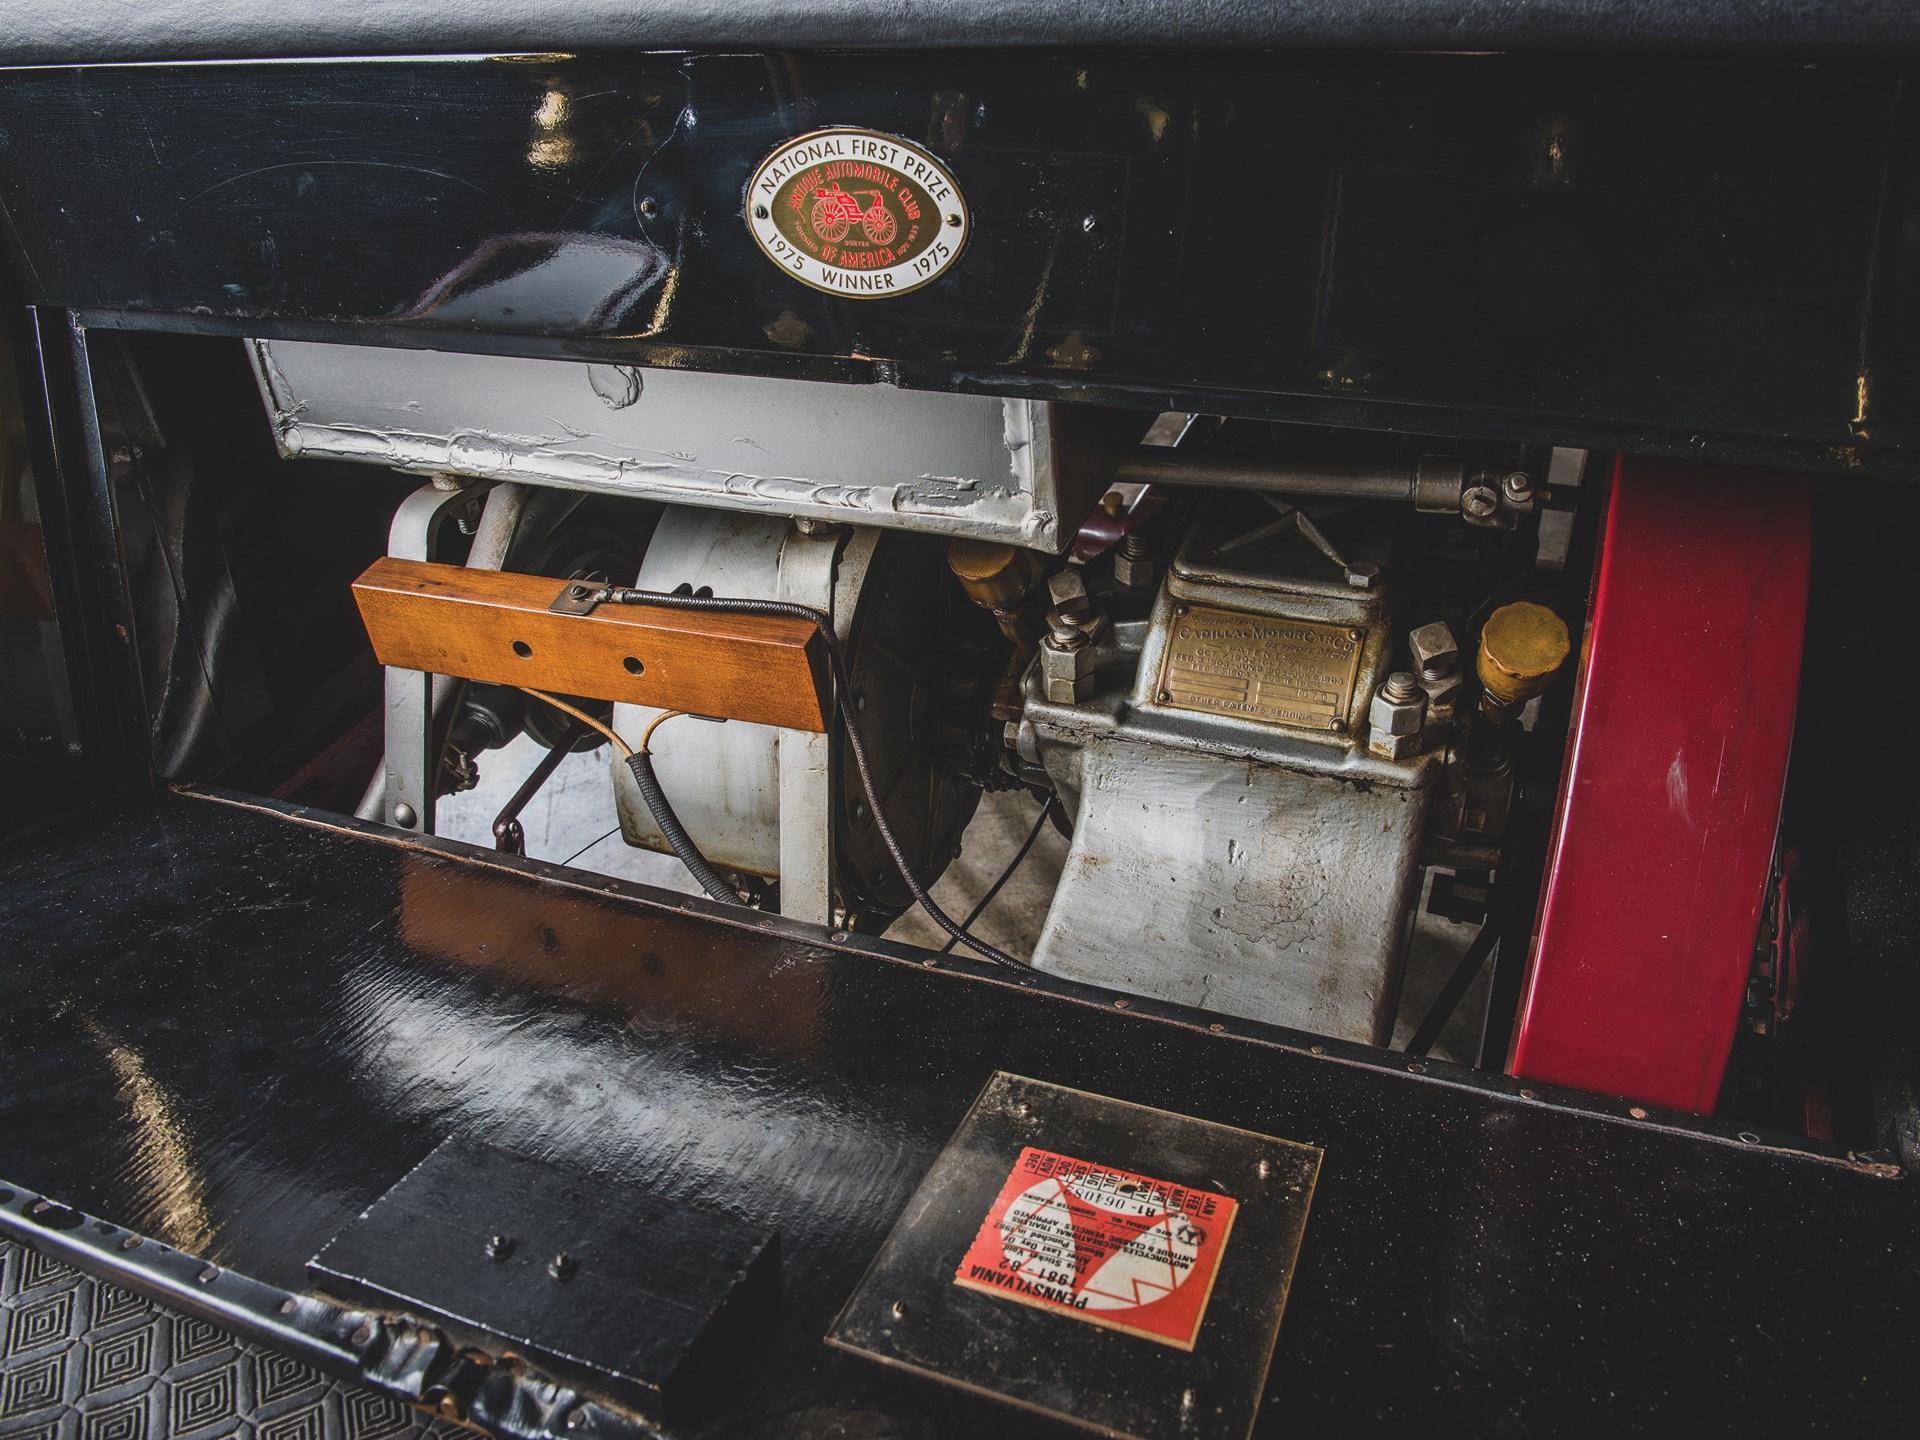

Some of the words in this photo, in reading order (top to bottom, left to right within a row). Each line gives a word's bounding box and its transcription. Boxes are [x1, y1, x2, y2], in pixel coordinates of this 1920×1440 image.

[761, 139, 844, 195] NATIONAL
[851, 139, 899, 164] FIRST
[903, 155, 951, 202] PRIZE
[789, 168, 824, 212] ANTIQUE
[824, 161, 899, 193] AUTOMOBILE
[897, 187, 921, 221] CLUB
[767, 233, 807, 270] 1975
[821, 244, 838, 262] OF
[839, 247, 896, 269] AMERICA
[911, 241, 950, 278] 1975
[821, 267, 895, 290] WINNER
[1023, 1152, 1041, 1169] DEC
[1039, 1156, 1057, 1175] NOV
[1056, 1160, 1072, 1177] OCT
[1073, 1165, 1088, 1180] SEP
[1087, 1168, 1103, 1186] AUG
[1103, 1173, 1120, 1188] JUL
[1022, 1192, 1055, 1206] READING
[1152, 1184, 1168, 1202] APR
[1168, 1188, 1186, 1208] MAR
[1185, 1194, 1202, 1210] FEB
[1201, 1197, 1218, 1216] JAN
[1010, 1216, 1053, 1233] TRAILERS
[1012, 1210, 1060, 1229] APPROVED
[1001, 1234, 1016, 1246] Of
[1016, 1227, 1029, 1239] in
[1029, 1231, 1072, 1251] Punched
[1018, 1236, 1039, 1252] Day
[1041, 1243, 1063, 1258] Last
[1108, 1234, 1147, 1251] CLASSIC
[1002, 1244, 1024, 1259] Void
[1064, 1250, 1092, 1266] After
[1073, 1244, 1106, 1260] Month
[1156, 1246, 1197, 1264] ANTIQUE
[997, 1258, 1023, 1273] 82
[1027, 1251, 1064, 1270] Sticker
[1069, 1260, 1088, 1276] This
[970, 1264, 1090, 1310] PENNSYLVANIA
[1037, 1269, 1078, 1288] 1981
